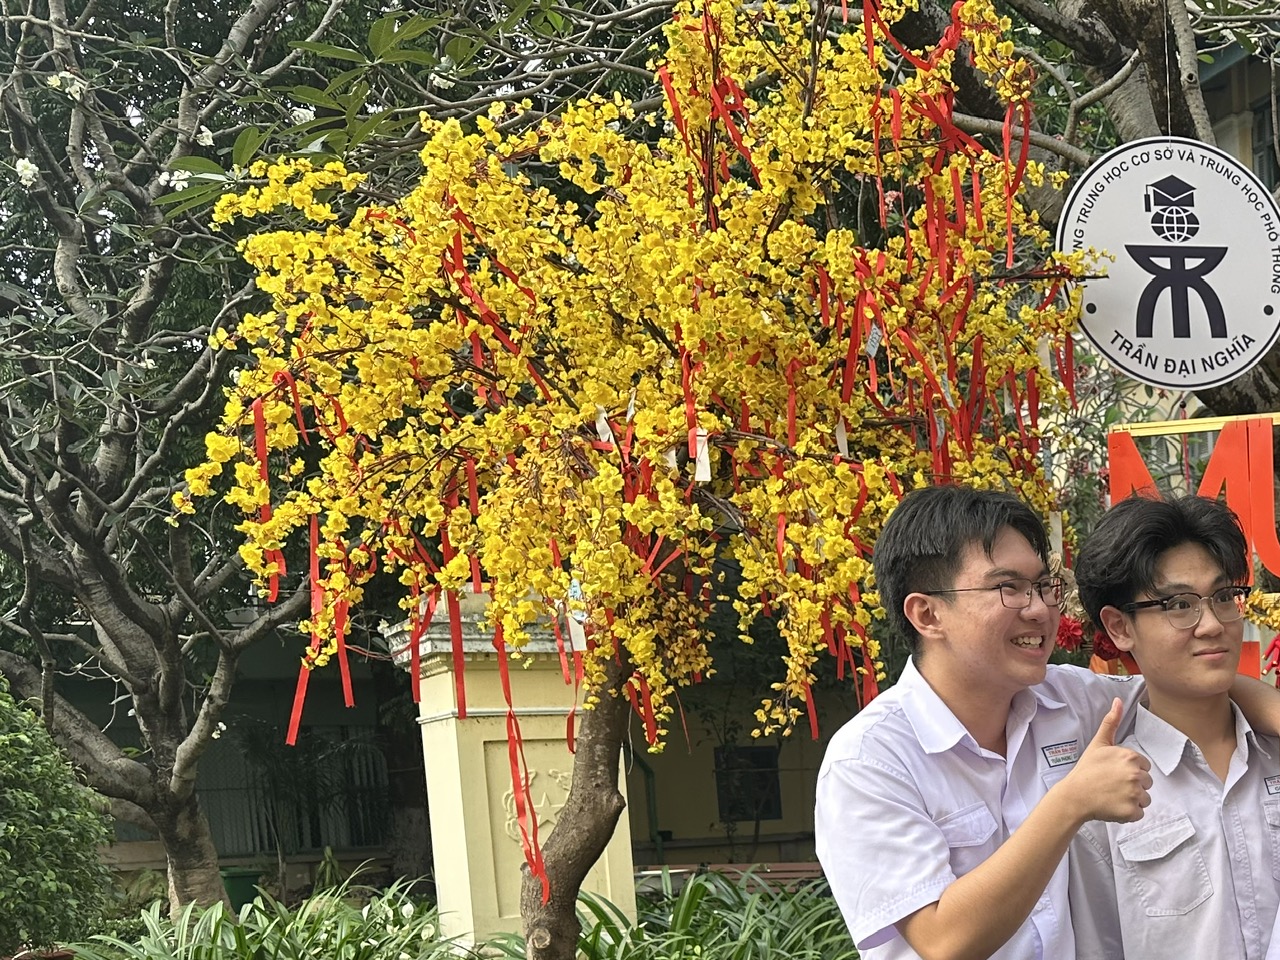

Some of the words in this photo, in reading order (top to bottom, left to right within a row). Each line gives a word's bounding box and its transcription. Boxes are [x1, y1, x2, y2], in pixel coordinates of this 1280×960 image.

[1077, 182, 1105, 225] TRUNG
[1103, 161, 1130, 180] HỌC
[1131, 151, 1150, 166] CƠ
[1154, 146, 1174, 161] SỞ
[1177, 149, 1195, 163] VÀ
[1199, 154, 1242, 186] TRUNG
[1241, 186, 1265, 212] HỌC
[1109, 330, 1159, 370] TRẦN
[1164, 358, 1196, 379] ĐẠI
[1203, 333, 1256, 372] NGHĨA
